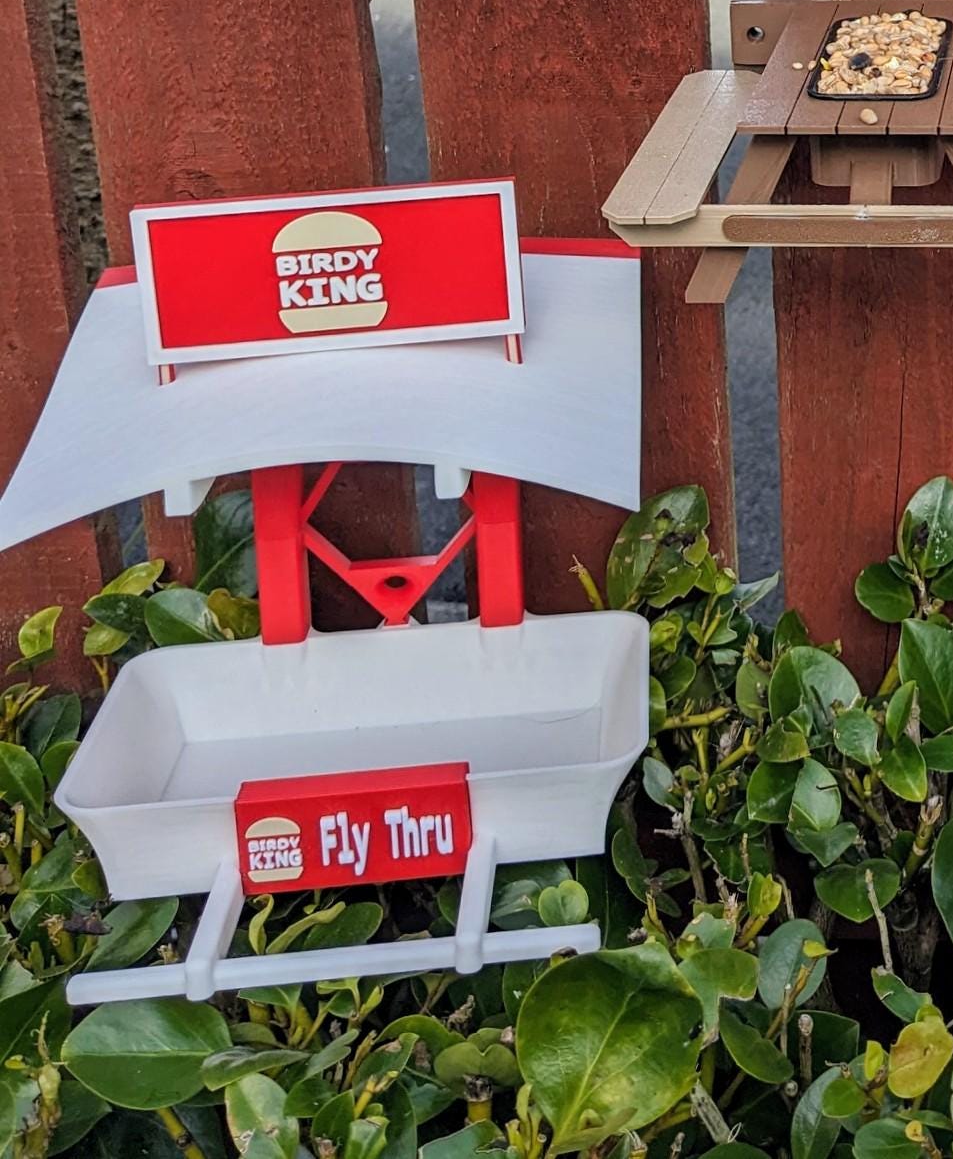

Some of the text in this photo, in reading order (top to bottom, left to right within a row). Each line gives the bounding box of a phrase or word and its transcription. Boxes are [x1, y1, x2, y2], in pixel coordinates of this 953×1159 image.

[276, 248, 379, 277] BIRDY
[278, 273, 384, 308] KING
[248, 836, 300, 853] BIRDY
[320, 806, 454, 876] Fly Thru
[249, 848, 302, 871] KING
